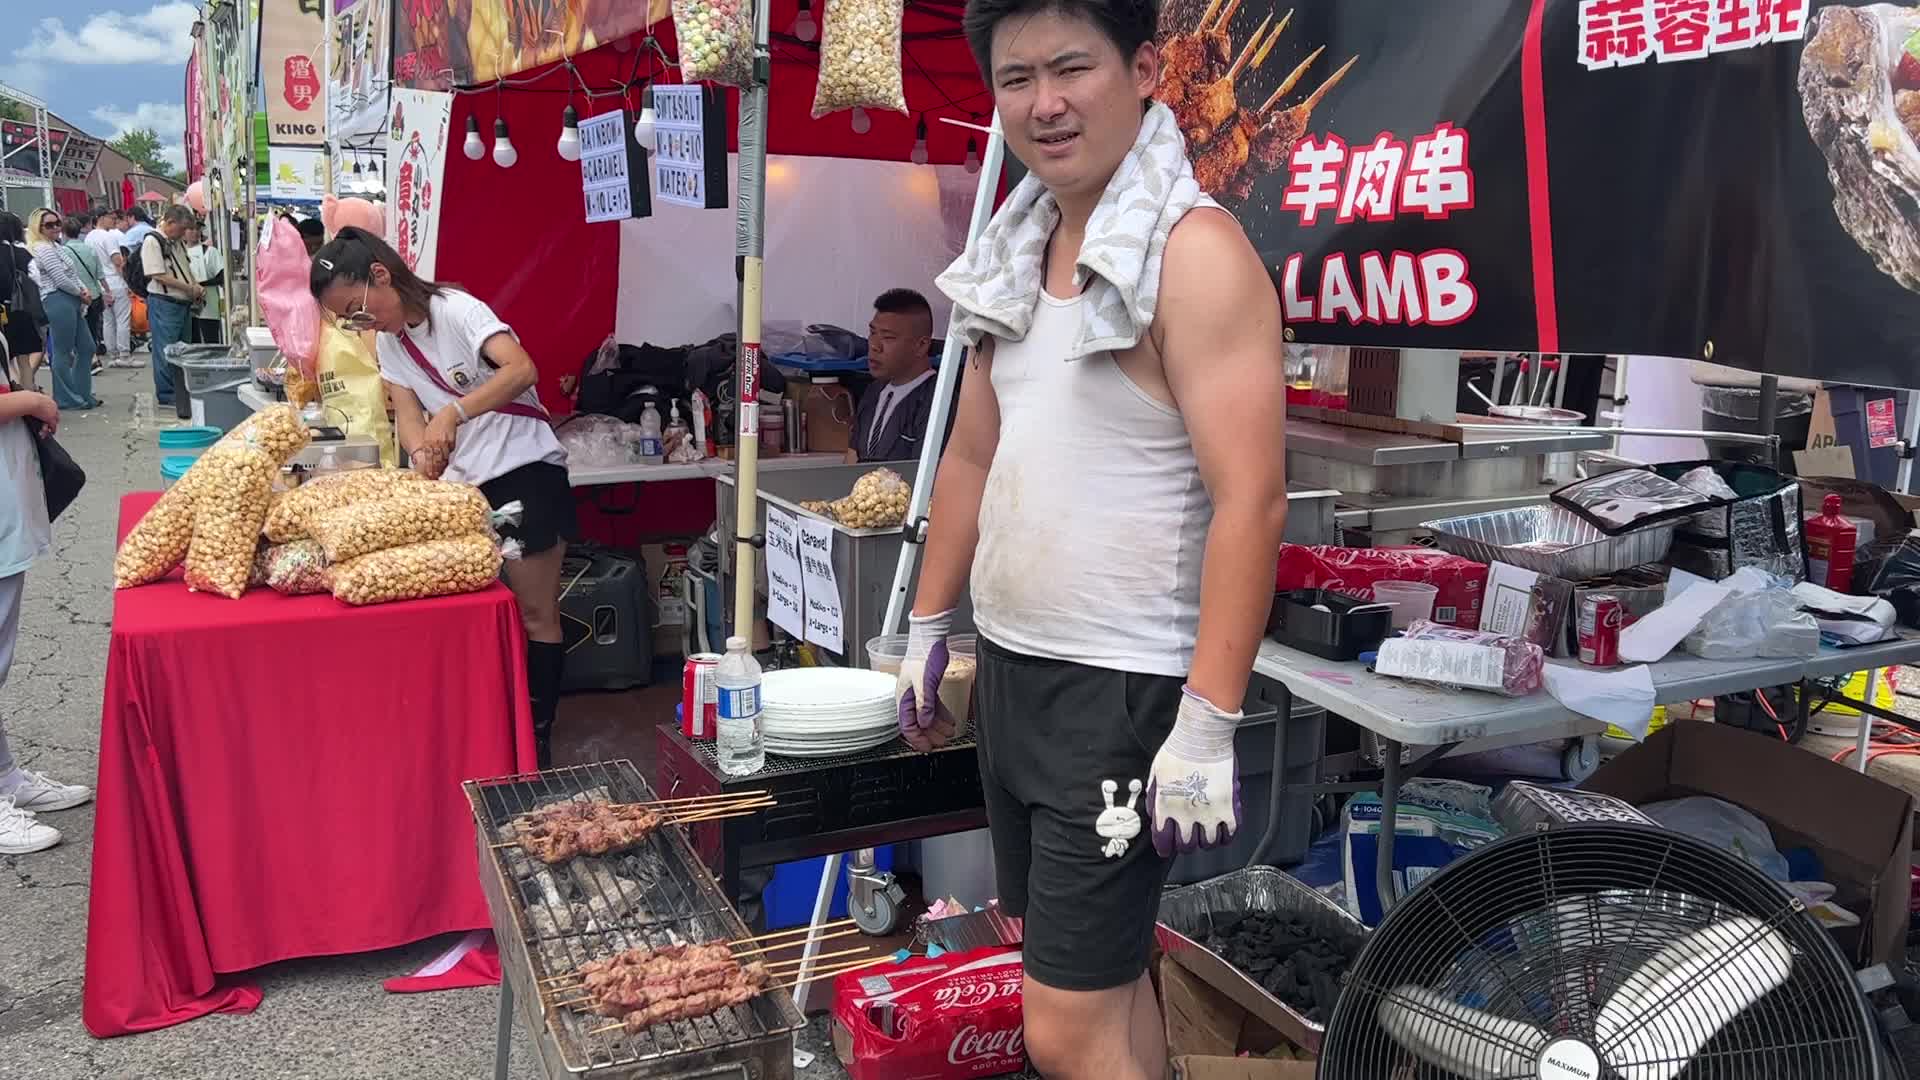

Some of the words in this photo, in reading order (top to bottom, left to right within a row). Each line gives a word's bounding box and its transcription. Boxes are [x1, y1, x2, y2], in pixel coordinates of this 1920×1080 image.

[288, 58, 313, 105] 渣男
[275, 123, 317, 135] KING
[1283, 124, 1472, 223] 羊肉串
[1282, 250, 1477, 324] LAMB
[801, 528, 828, 552] Caramel
[1547, 1057, 1591, 1080] MAXIMUM
